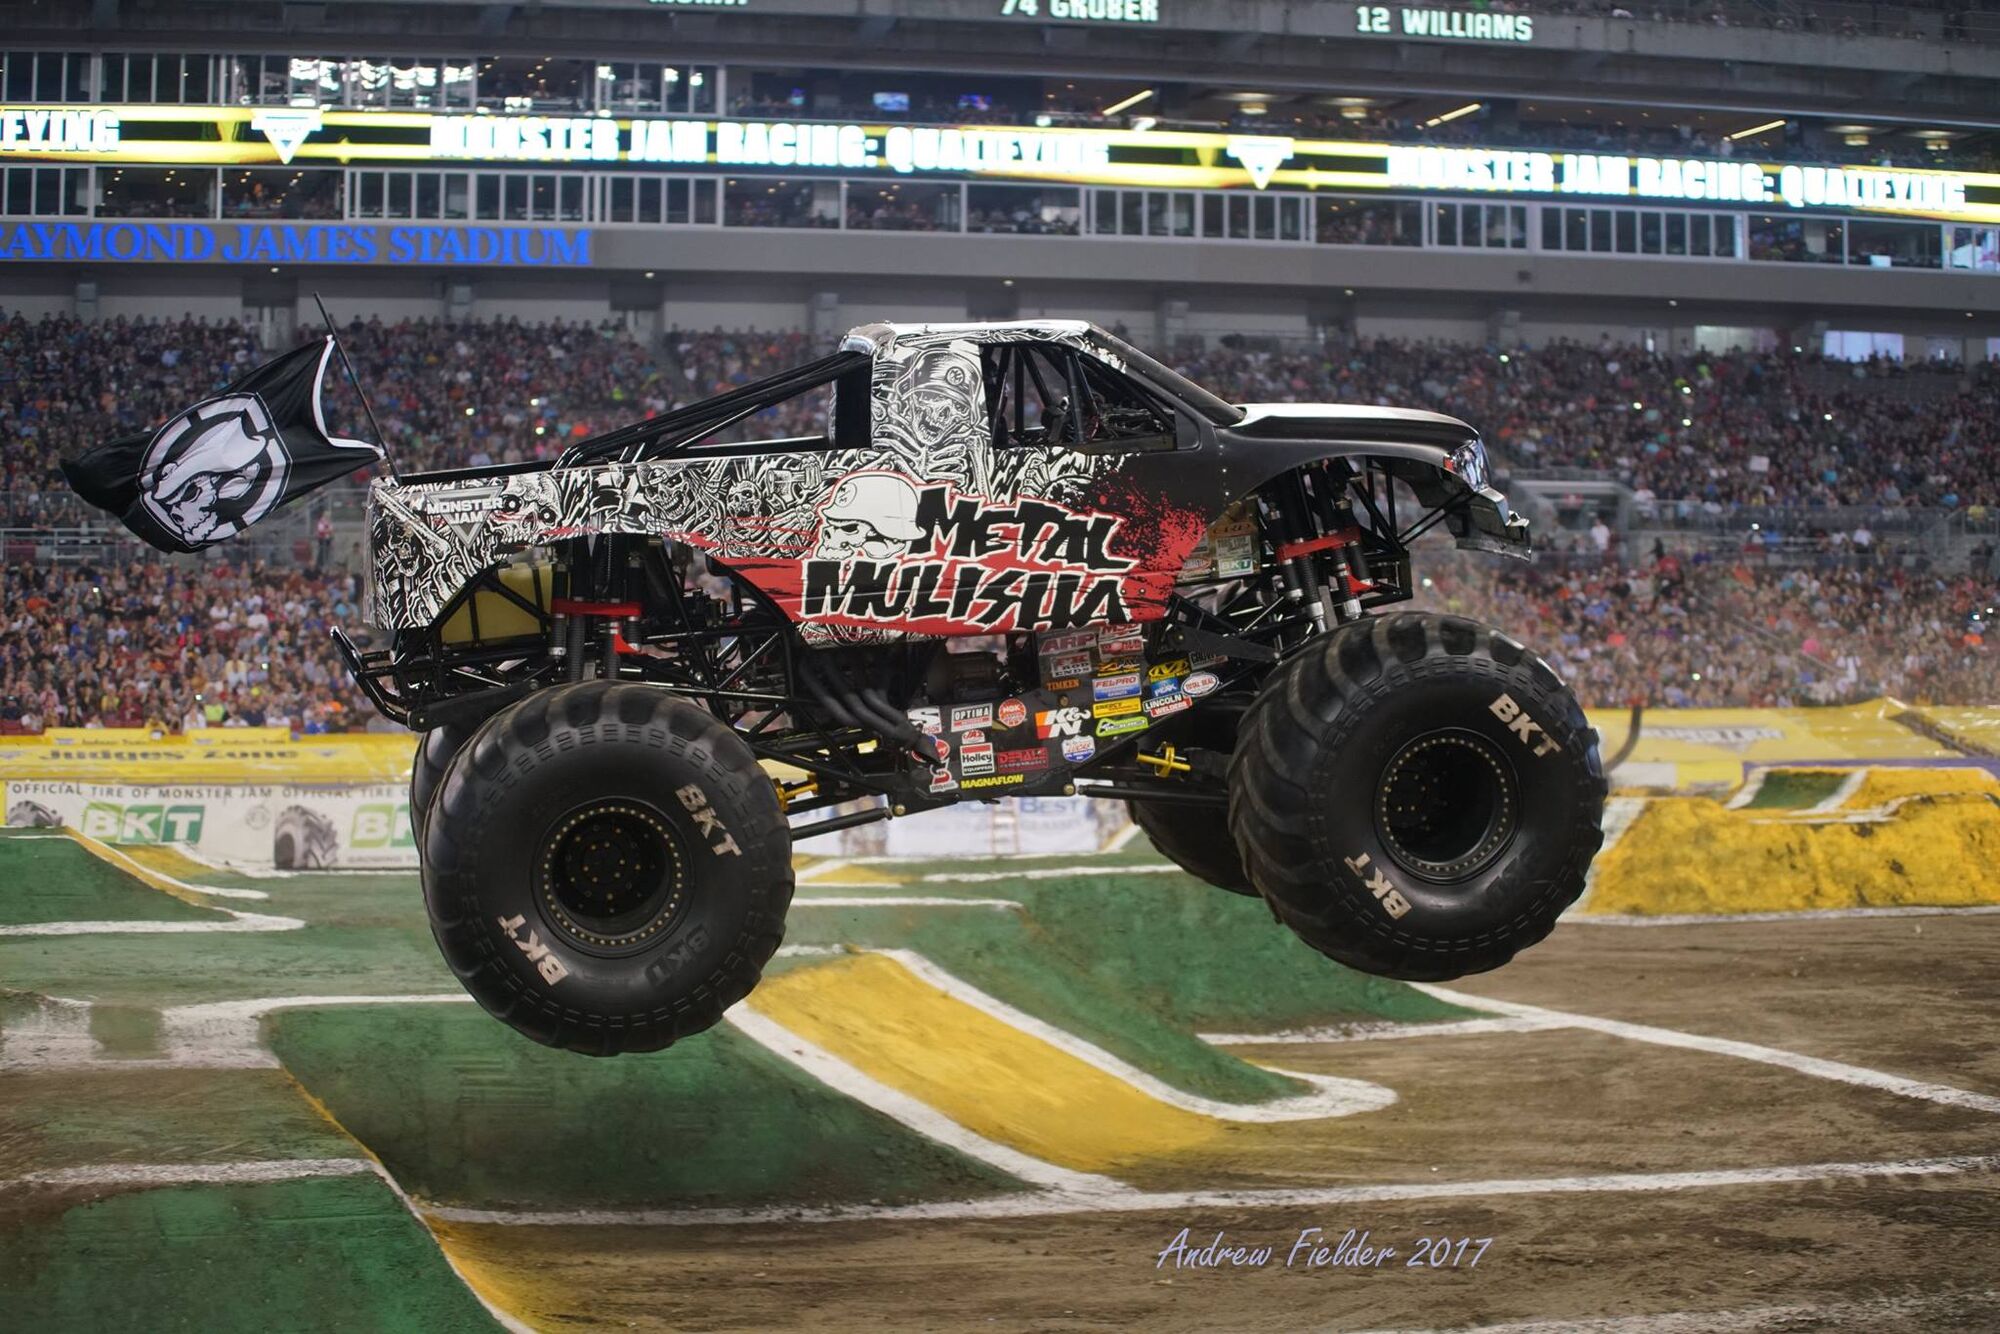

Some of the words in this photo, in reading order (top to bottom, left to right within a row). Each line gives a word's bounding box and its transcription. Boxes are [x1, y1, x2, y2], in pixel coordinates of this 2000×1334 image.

[1050, 0, 1158, 22] GRUBER
[1357, 6, 1391, 33] 12
[1402, 8, 1533, 41] WILLIAMS
[0, 108, 119, 152] FYING
[430, 116, 619, 161] MONSTER
[628, 119, 707, 162] JAM
[716, 121, 878, 168] RACING:
[1387, 146, 1554, 192] MONSTER
[1562, 154, 1630, 195] JAM
[1637, 157, 1774, 202] RACING:
[223, 225, 378, 263] JAMES
[388, 226, 592, 266] STADIUM
[427, 498, 503, 514] MONSTER
[451, 512, 484, 524] JAM
[908, 487, 1136, 571] METAL
[803, 560, 1134, 629] MULISHA
[1041, 633, 1097, 652] ARP
[1046, 679, 1079, 691] TIMKEN
[1145, 694, 1182, 710] LINCOLN
[955, 707, 989, 720] OPTIMA
[1488, 693, 1562, 757] BKT
[962, 753, 993, 765] Holley
[12, 782, 82, 796] OFFICIAL
[92, 786, 124, 798] TIRE
[132, 787, 150, 798] OF
[159, 787, 233, 799] MONSTER
[241, 787, 272, 798] JAM
[961, 774, 1024, 789] MAGNAFLOW
[86, 806, 202, 840] BKT
[676, 784, 742, 856] BKT
[1344, 852, 1412, 919] BKT
[498, 914, 569, 986] BKT
